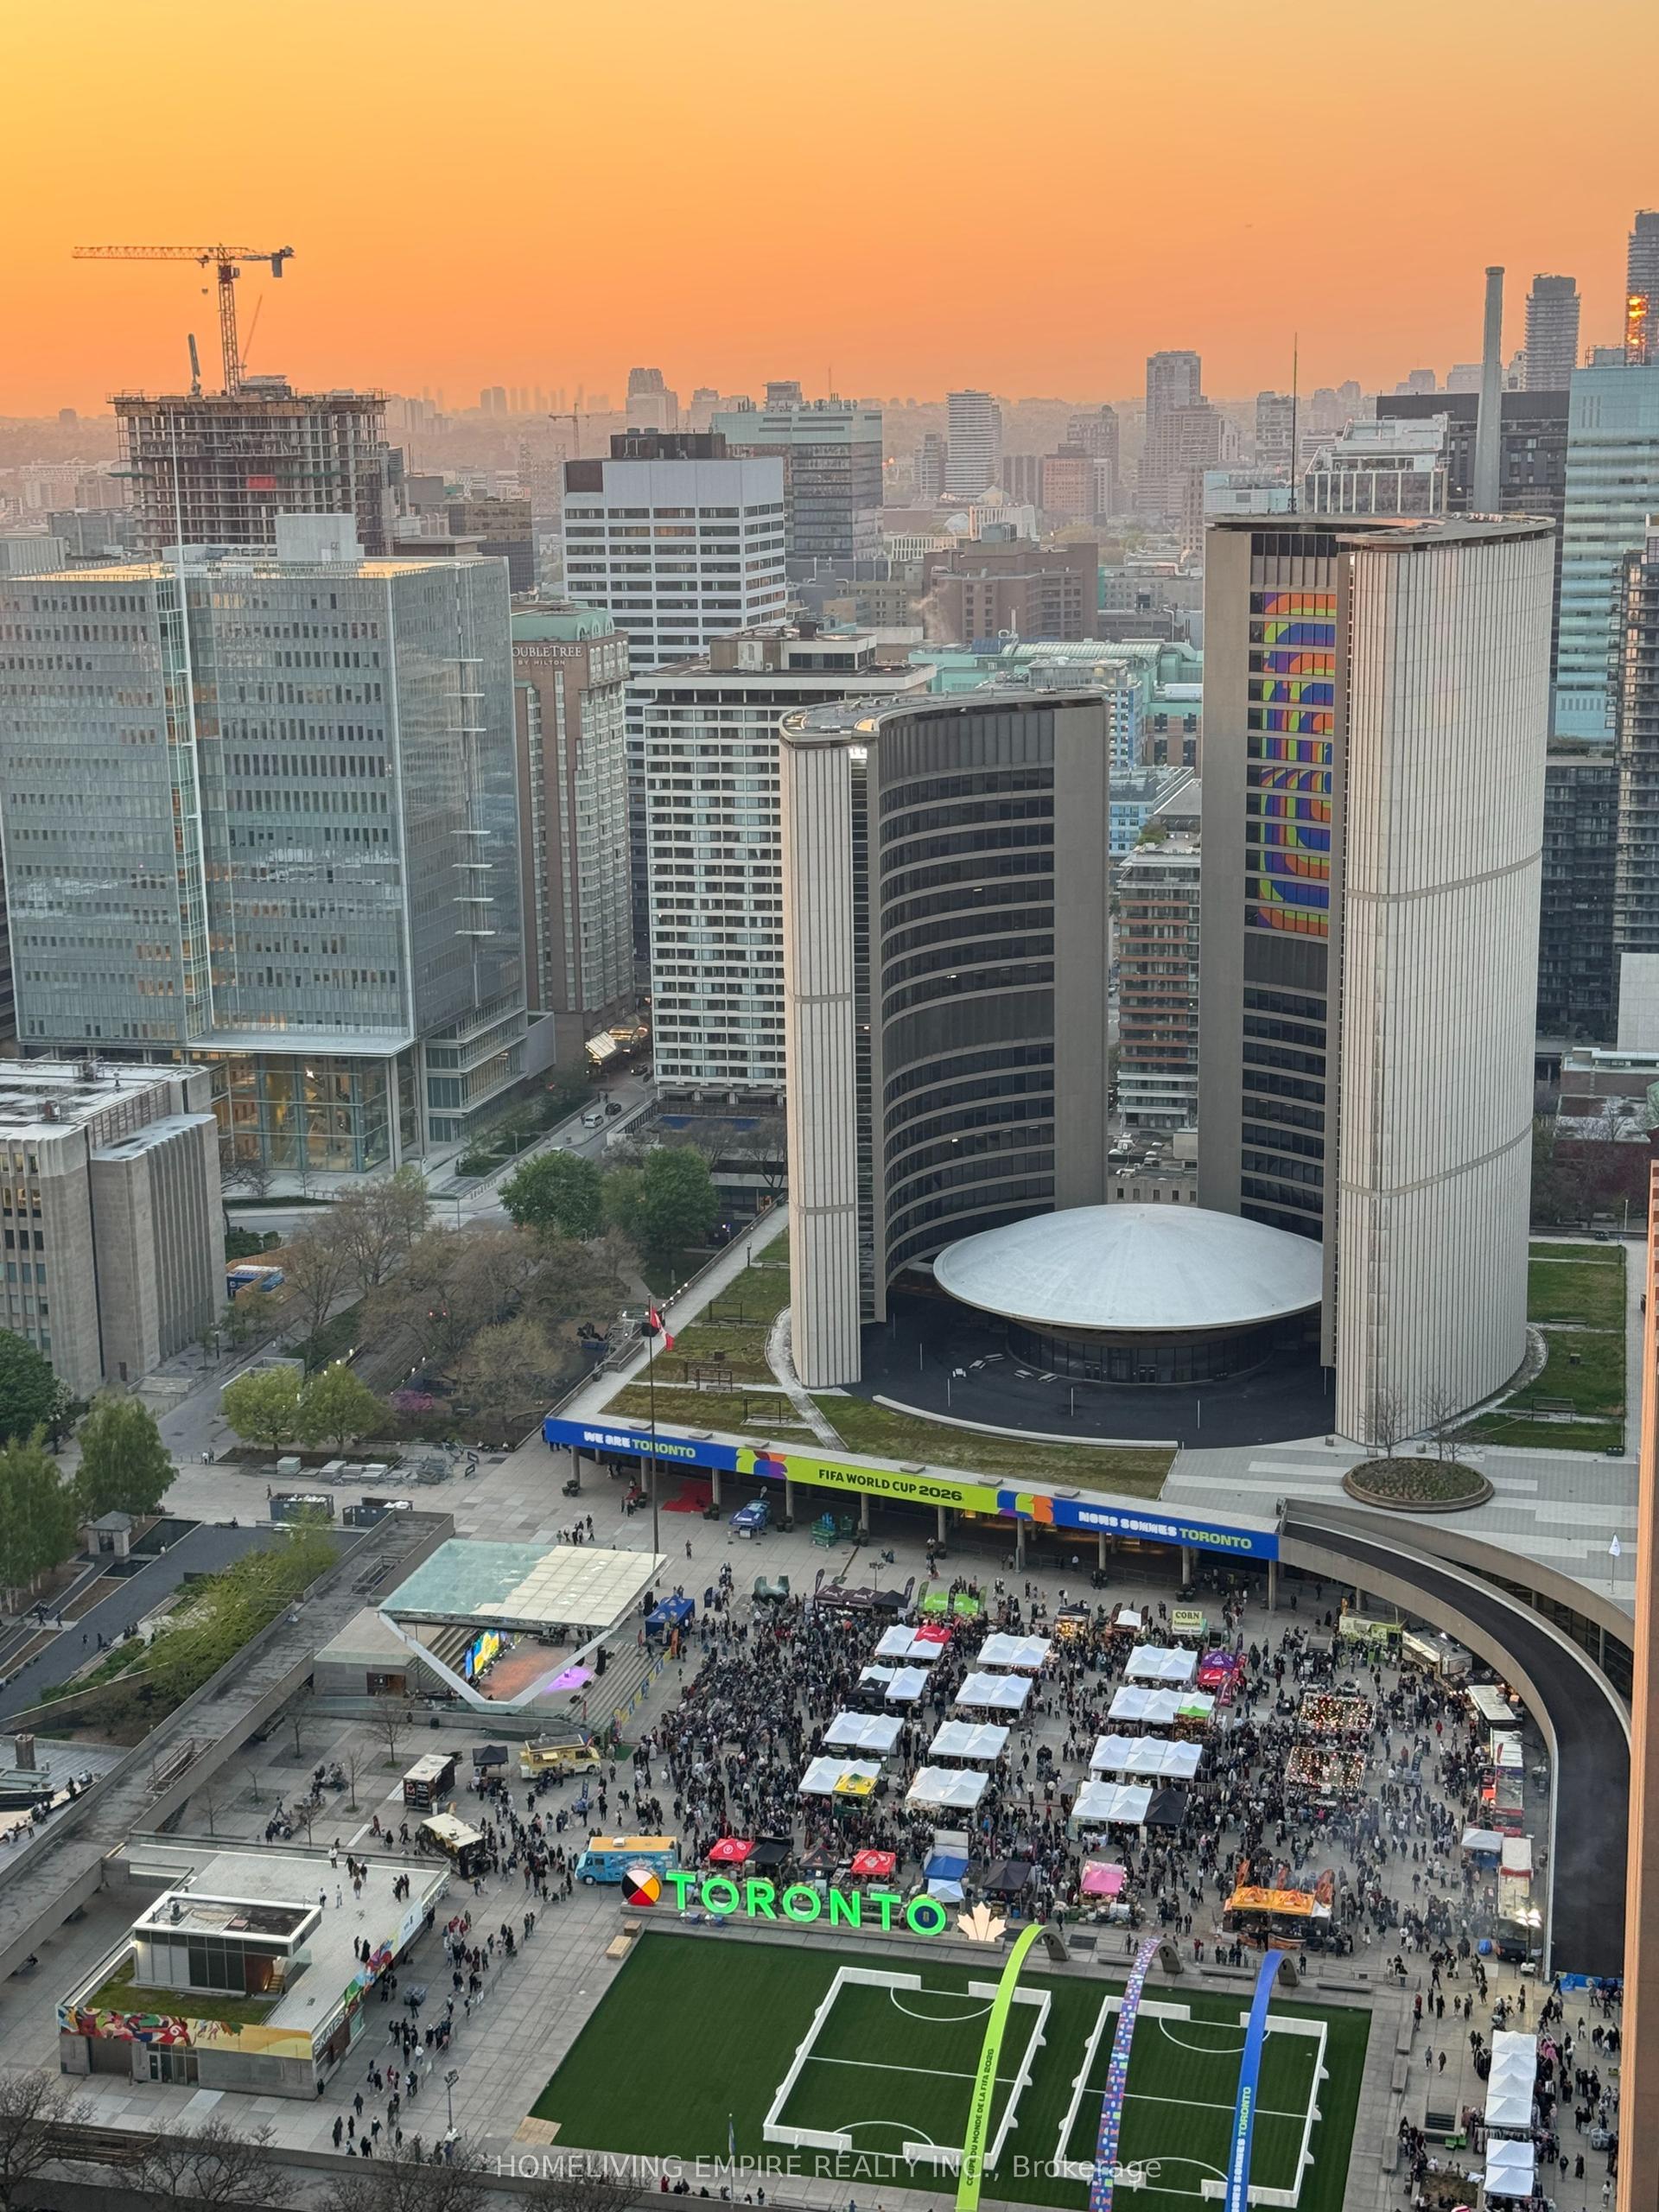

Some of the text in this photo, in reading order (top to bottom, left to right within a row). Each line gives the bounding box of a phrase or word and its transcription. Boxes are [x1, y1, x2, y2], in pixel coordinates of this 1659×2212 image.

[512, 645, 582, 658] OUBLETREE
[632, 1439, 696, 1459] TORONTO
[818, 1469, 963, 1502] FIFA WORLD CUP 2026
[1179, 1528, 1252, 1549] TORONTO
[666, 1870, 948, 1936] TORONTO
[979, 2089, 986, 2102] LA
[977, 2103, 984, 2113] DE
[1238, 2087, 1251, 2137] TORONTO
[972, 2115, 982, 2144] MONDE
